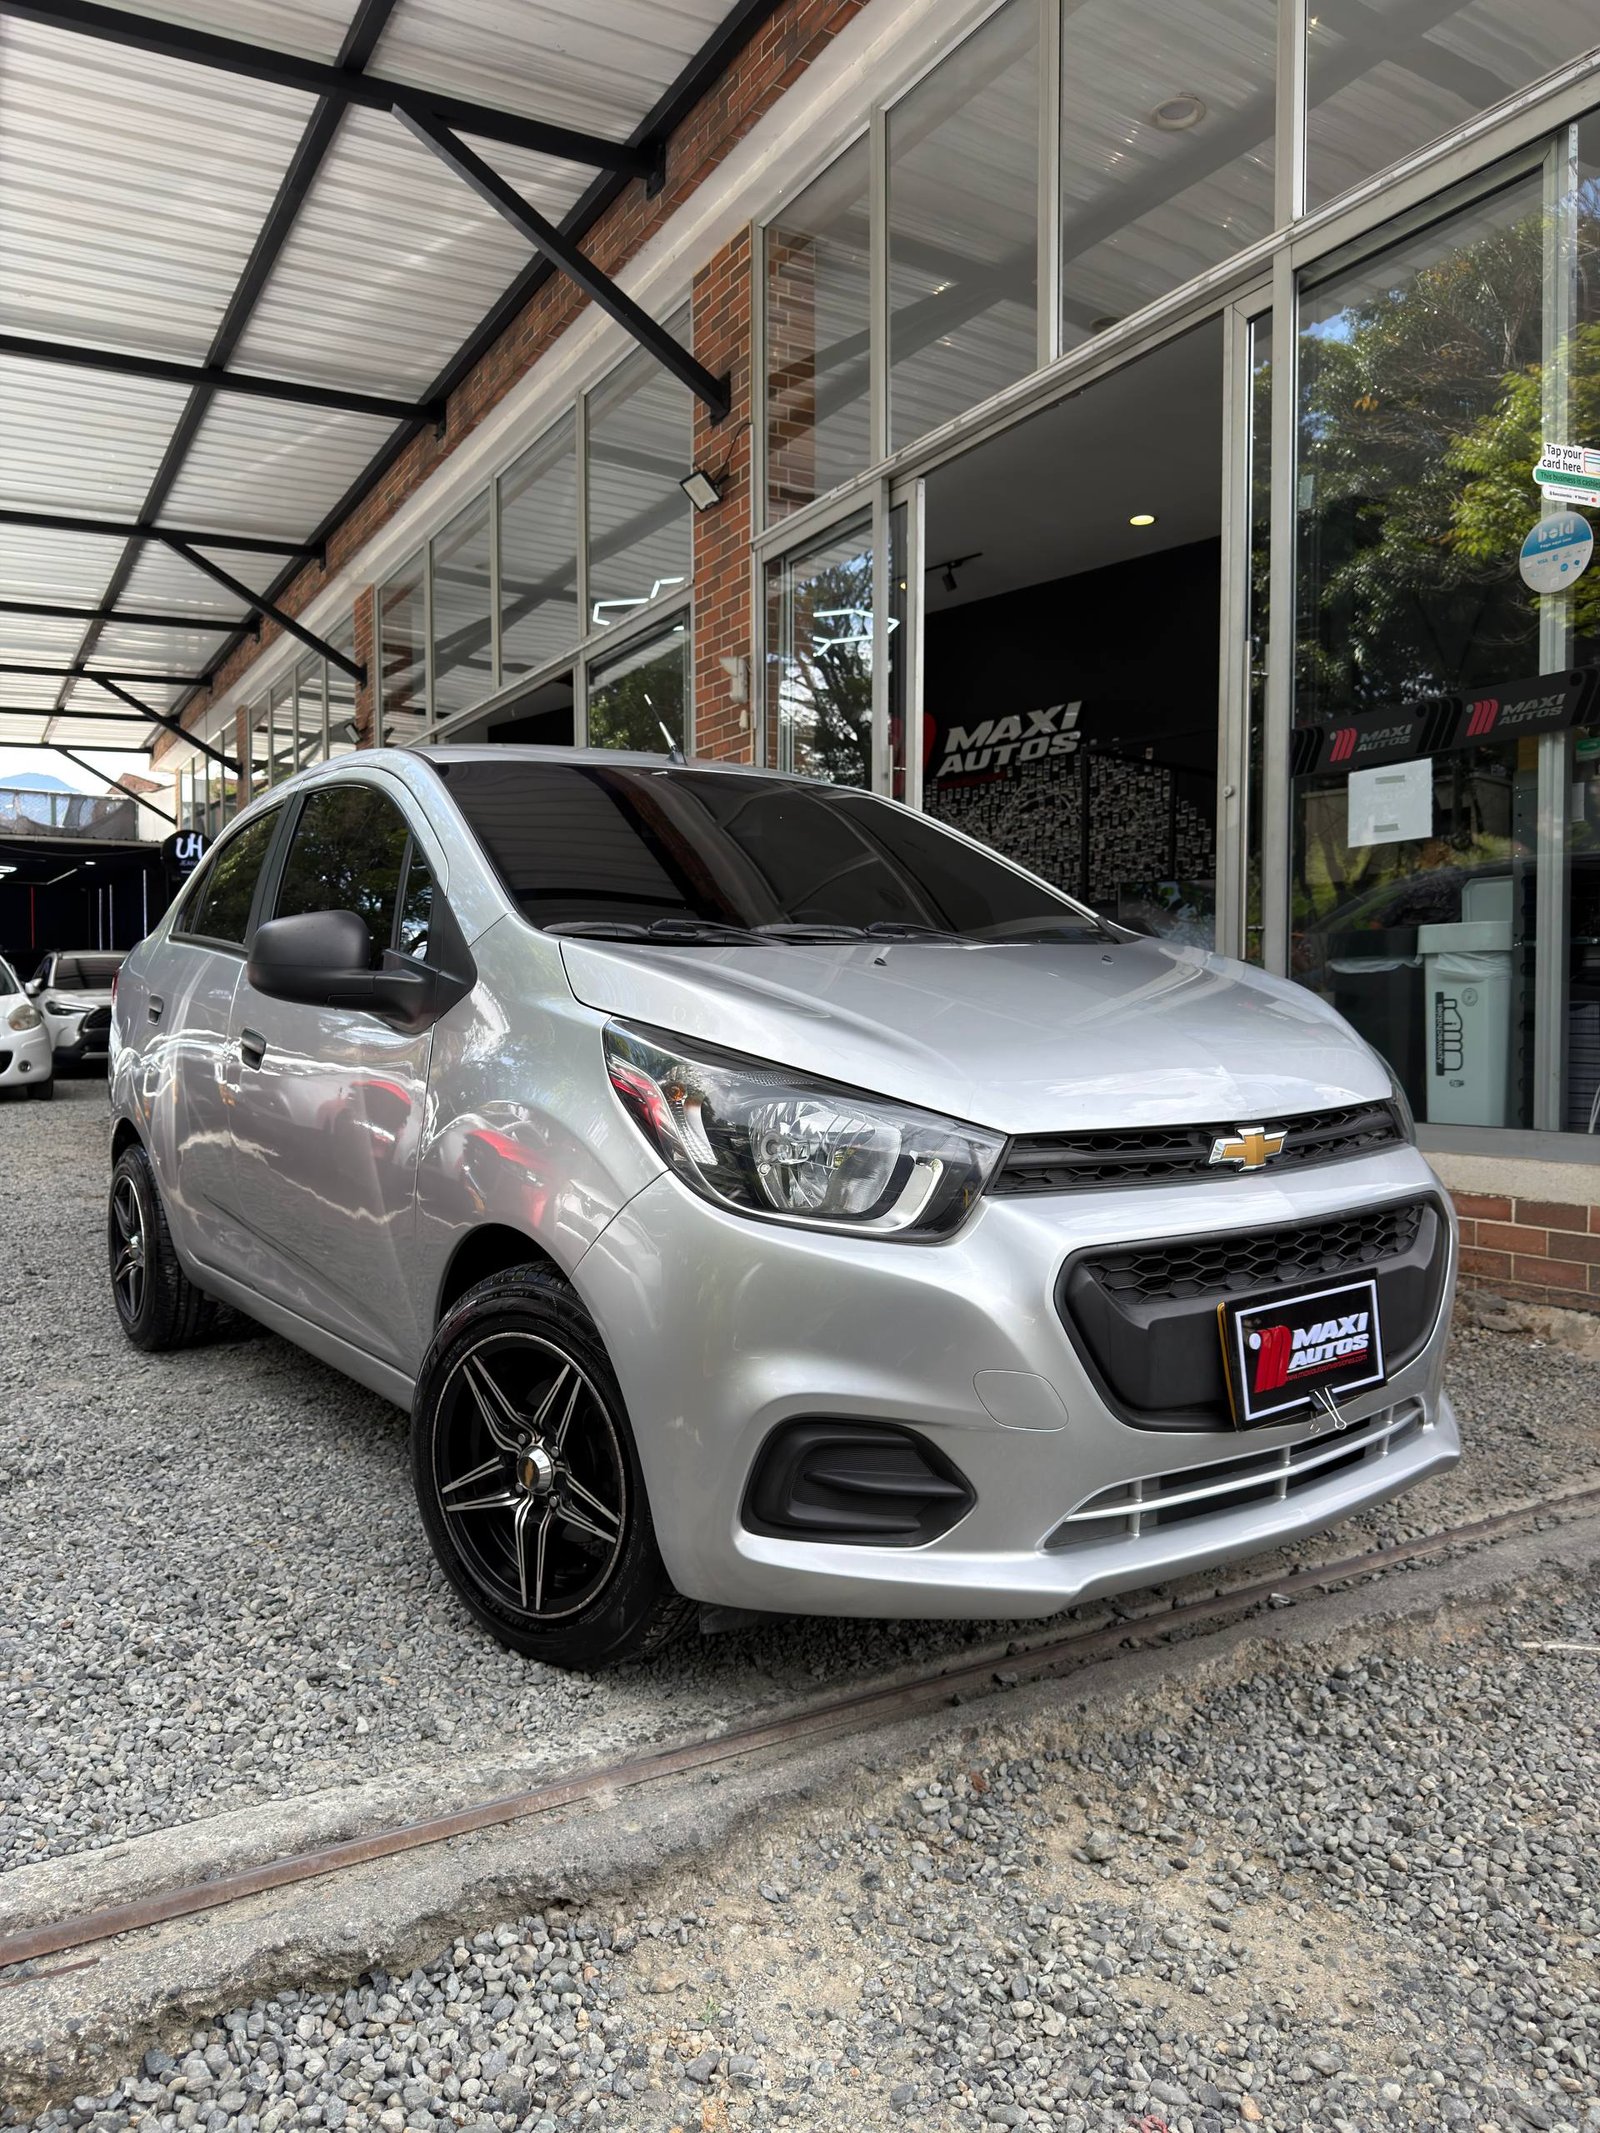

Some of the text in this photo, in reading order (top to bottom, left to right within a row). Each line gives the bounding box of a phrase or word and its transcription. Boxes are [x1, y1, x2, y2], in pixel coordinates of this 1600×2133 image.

[1546, 444, 1582, 460] Tap your
[1542, 459, 1584, 474] card here.
[1540, 472, 1552, 480] This
[1552, 474, 1576, 484] business
[1537, 519, 1575, 543] bold
[1502, 693, 1566, 714] MAXI
[1498, 705, 1564, 726] AUTOS
[943, 700, 1083, 753] MAXI
[1359, 724, 1412, 743] MAXI
[935, 731, 1082, 778] AUTOS
[1356, 735, 1411, 753] AUTOS
[1292, 1311, 1369, 1350] MAXI
[1288, 1333, 1370, 1370] AUTOS
